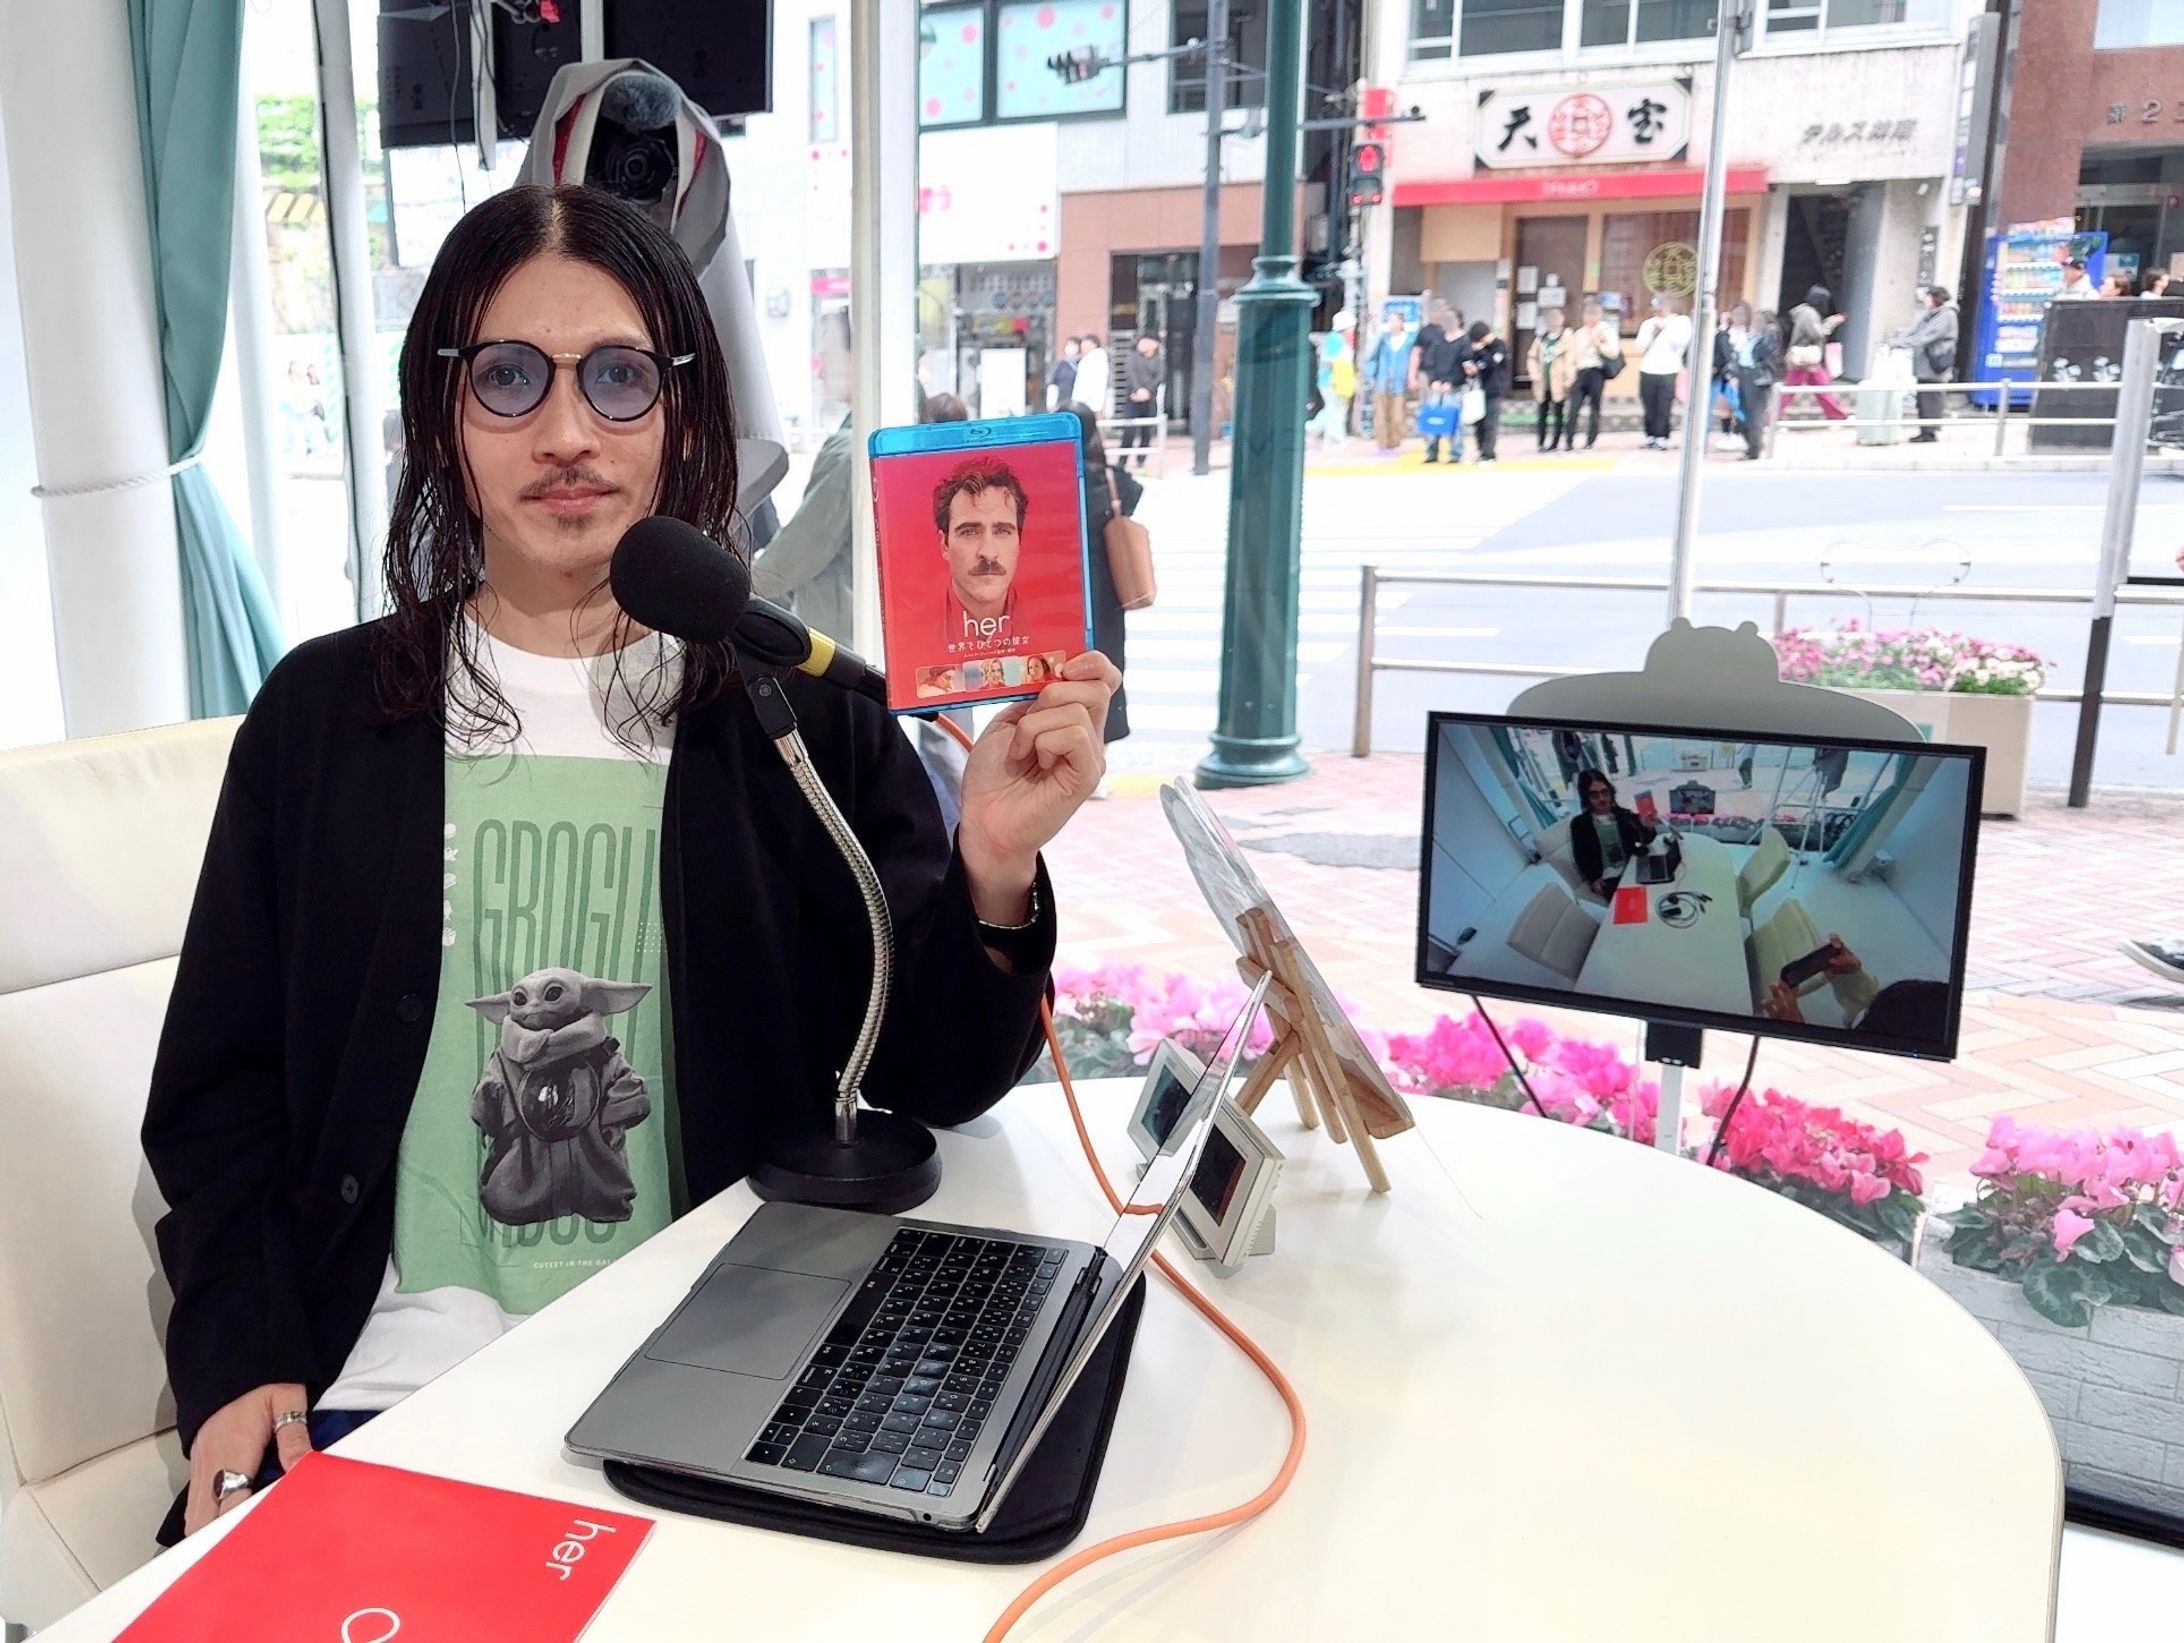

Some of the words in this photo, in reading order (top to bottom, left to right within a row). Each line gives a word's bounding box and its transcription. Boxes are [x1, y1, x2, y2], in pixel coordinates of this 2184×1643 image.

[962, 610, 1011, 640] her
[578, 1259, 593, 1267] THE
[545, 1518, 617, 1581] her
